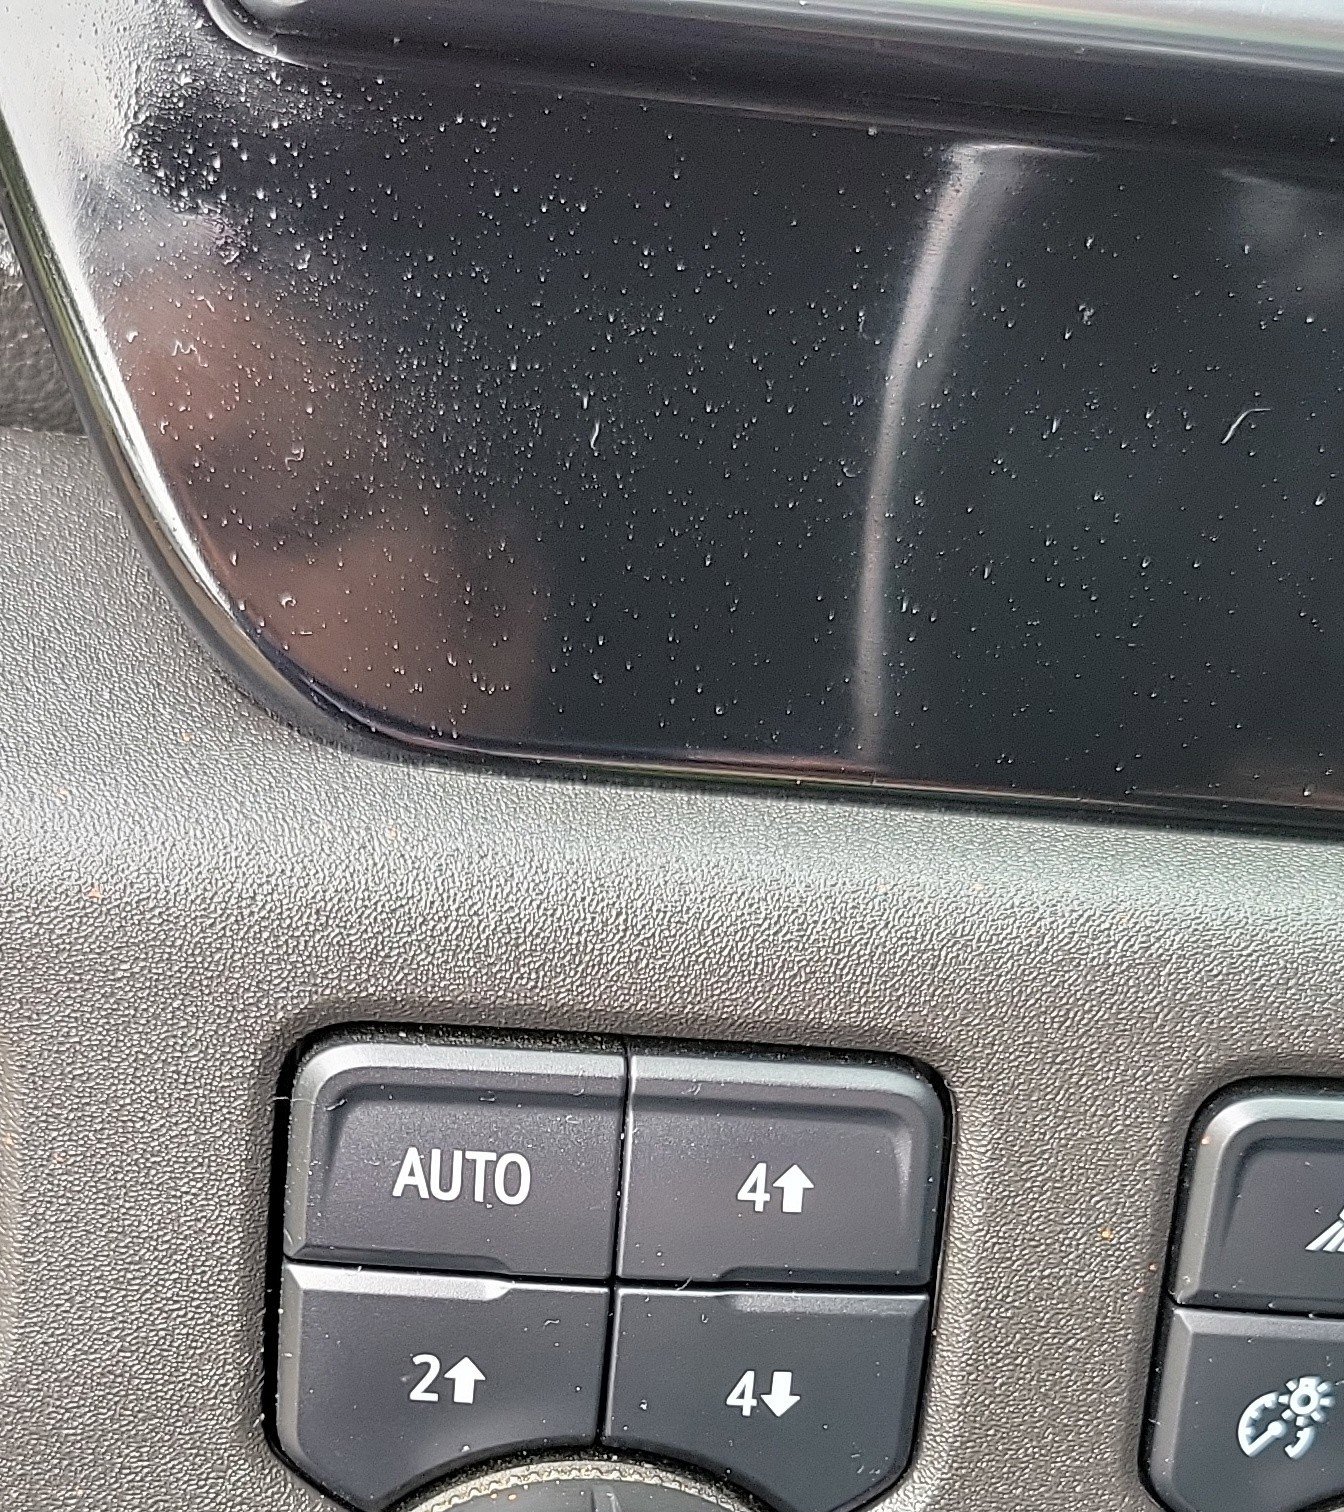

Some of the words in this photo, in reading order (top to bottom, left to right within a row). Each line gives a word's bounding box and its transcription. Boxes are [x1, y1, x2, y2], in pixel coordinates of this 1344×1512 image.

[392, 1147, 532, 1206] AUTO
[736, 1162, 771, 1213] 4
[409, 1353, 441, 1402] 2
[725, 1370, 758, 1417] 4
